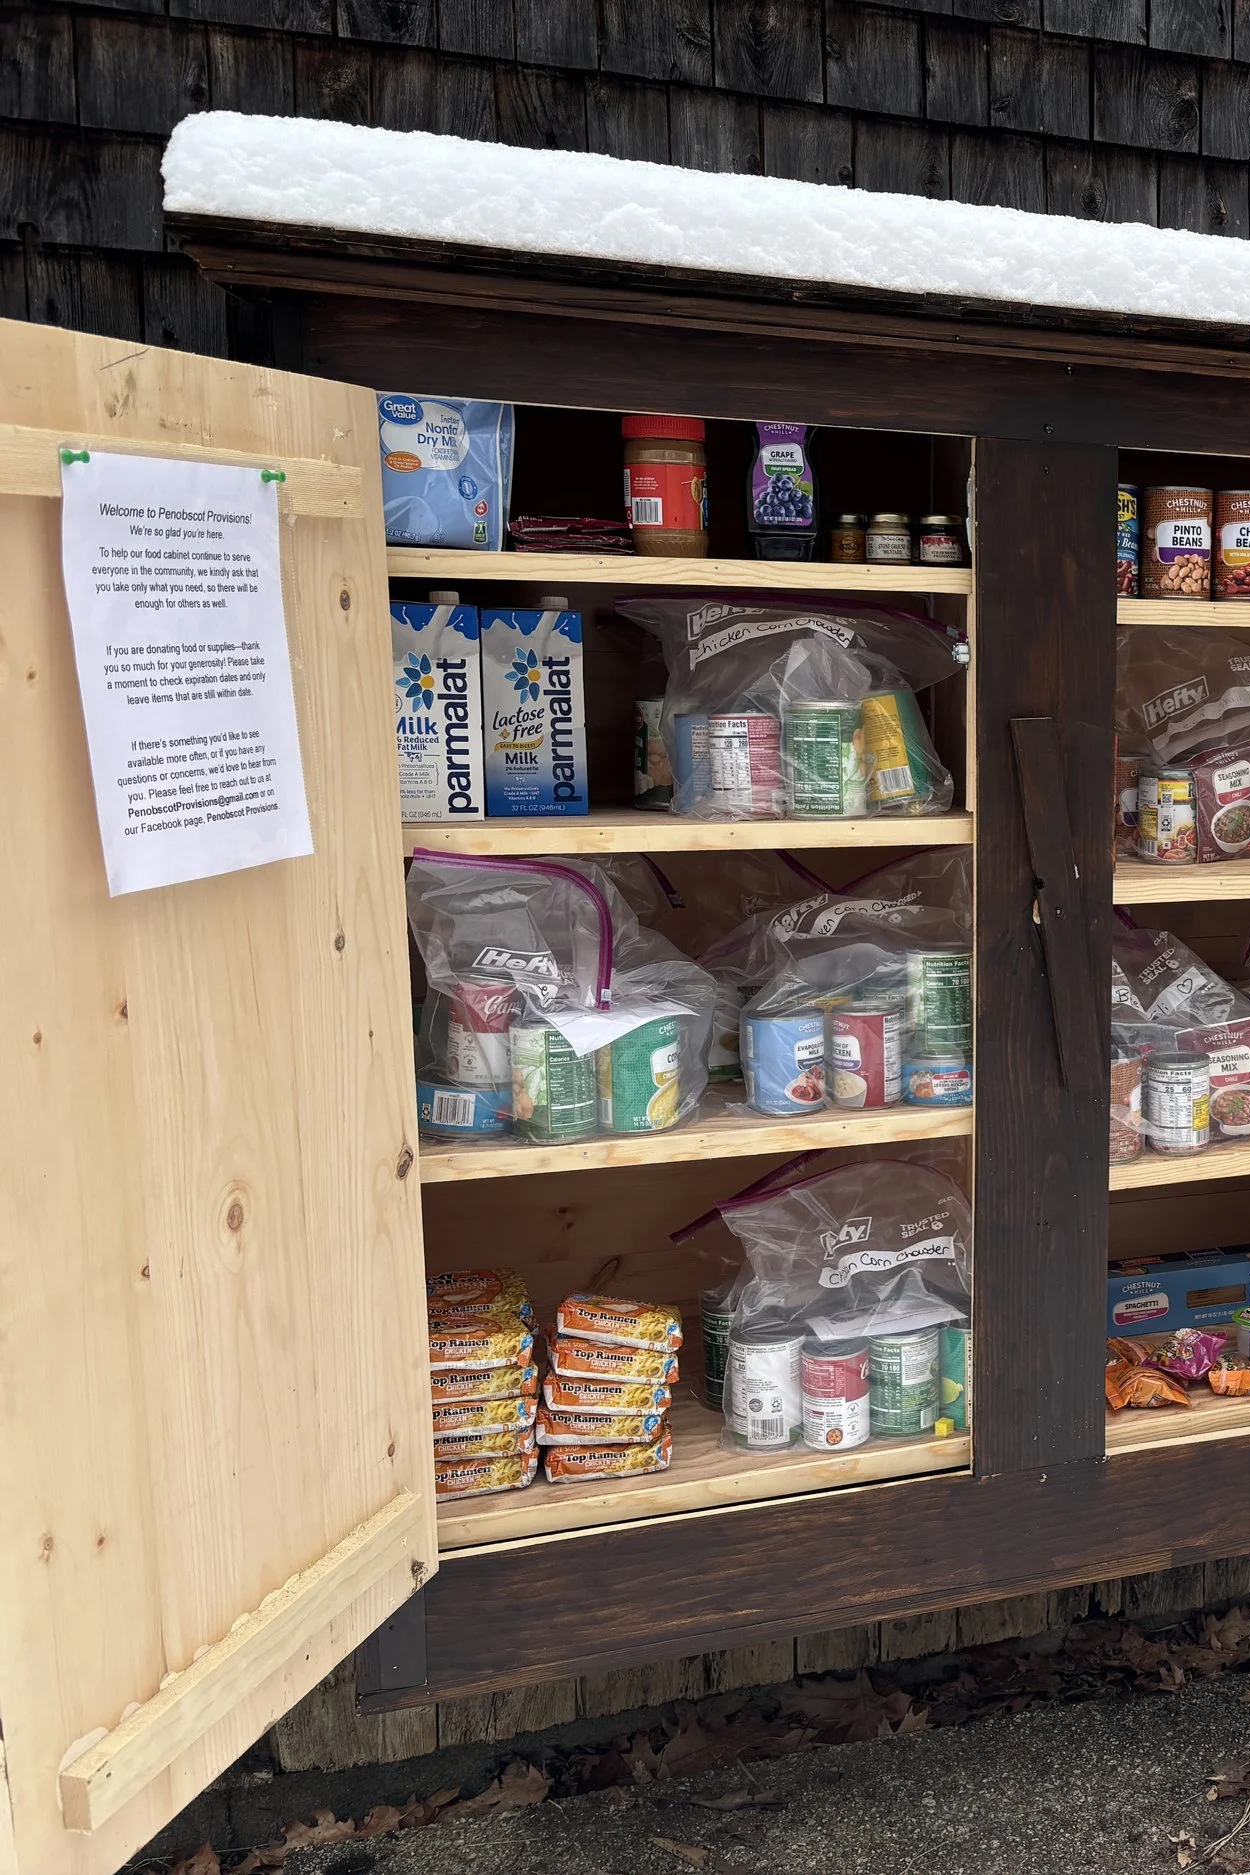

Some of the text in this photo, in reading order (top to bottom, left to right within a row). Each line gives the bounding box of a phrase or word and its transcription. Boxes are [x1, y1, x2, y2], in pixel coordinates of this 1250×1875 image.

[384, 401, 416, 412] Great
[392, 411, 416, 419] Value
[418, 434, 438, 446] Dry
[1167, 499, 1207, 510] CHESTNUT
[99, 505, 252, 525] Welcome to Penobscot Provisions!
[130, 525, 224, 540] We're so glad you're here.
[1174, 525, 1201, 535] PINTO
[1172, 537, 1202, 546] BEANS
[99, 548, 251, 563] To help our food cabinet continue to serve
[92, 566, 259, 581] everyone in the community, we kindly ask that
[95, 582, 258, 595] you take only what you need, so there will be
[757, 619, 851, 643] Corn Chowder
[1148, 684, 1204, 723] Hefty
[493, 707, 545, 730] lactose
[512, 723, 543, 742] free
[542, 656, 582, 802] parmalat
[437, 658, 479, 814] parmalat
[506, 752, 538, 764] Milk
[1218, 768, 1249, 781] SEASONING
[127, 789, 275, 818] PenobscotProvisions@gmail.com or on
[124, 803, 281, 837] our Facebook page, Penobscot Provisions.
[1138, 947, 1176, 980] TRUSTED
[1143, 967, 1167, 985] SEAL
[1204, 1032, 1243, 1044] CHESTNUT
[1208, 1053, 1250, 1064] SEASONING
[1221, 1063, 1238, 1071] MIX
[900, 1212, 950, 1231] TRUSTED
[901, 1225, 929, 1238] SEAL
[860, 1253, 892, 1267] Corn
[1122, 1281, 1162, 1293] CHESTNUT
[1125, 1300, 1158, 1310] SPAGHETTI
[578, 1308, 637, 1324] Top Ramen
[574, 1350, 634, 1362] Top Ramen
[450, 1373, 490, 1383] Ramen
[561, 1383, 622, 1393] Top Ramen
[443, 1406, 484, 1416] Ramen
[551, 1414, 612, 1423] Top Ramen
[442, 1435, 482, 1444] Ramen
[565, 1451, 626, 1462] Top Ramen
[450, 1467, 491, 1478] Ramen
[447, 1477, 474, 1485] CHICKEN
